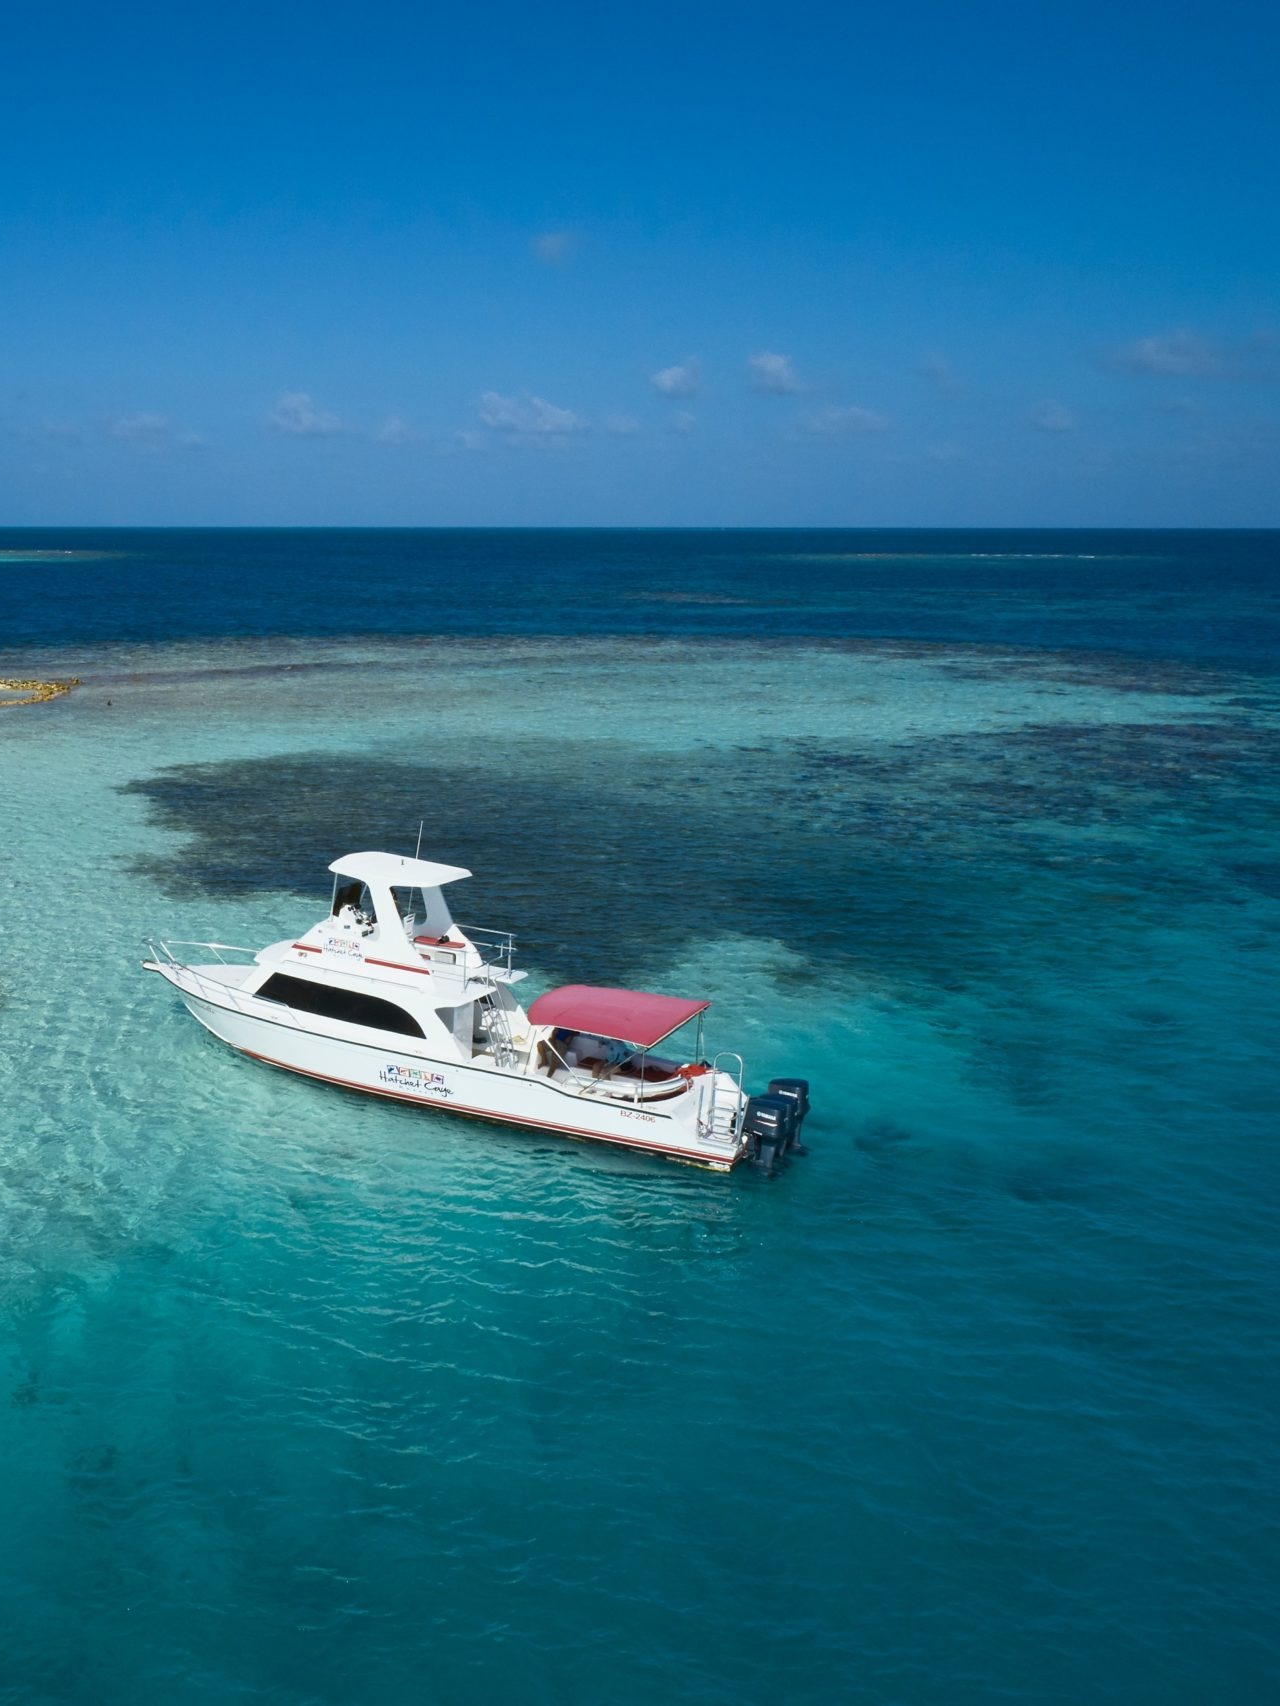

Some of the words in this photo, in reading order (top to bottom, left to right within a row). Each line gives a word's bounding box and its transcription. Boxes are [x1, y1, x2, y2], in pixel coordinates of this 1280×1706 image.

[379, 1069, 421, 1088] Hatchet
[423, 1081, 454, 1098] Caye
[620, 1109, 656, 1124] BZ-2406
